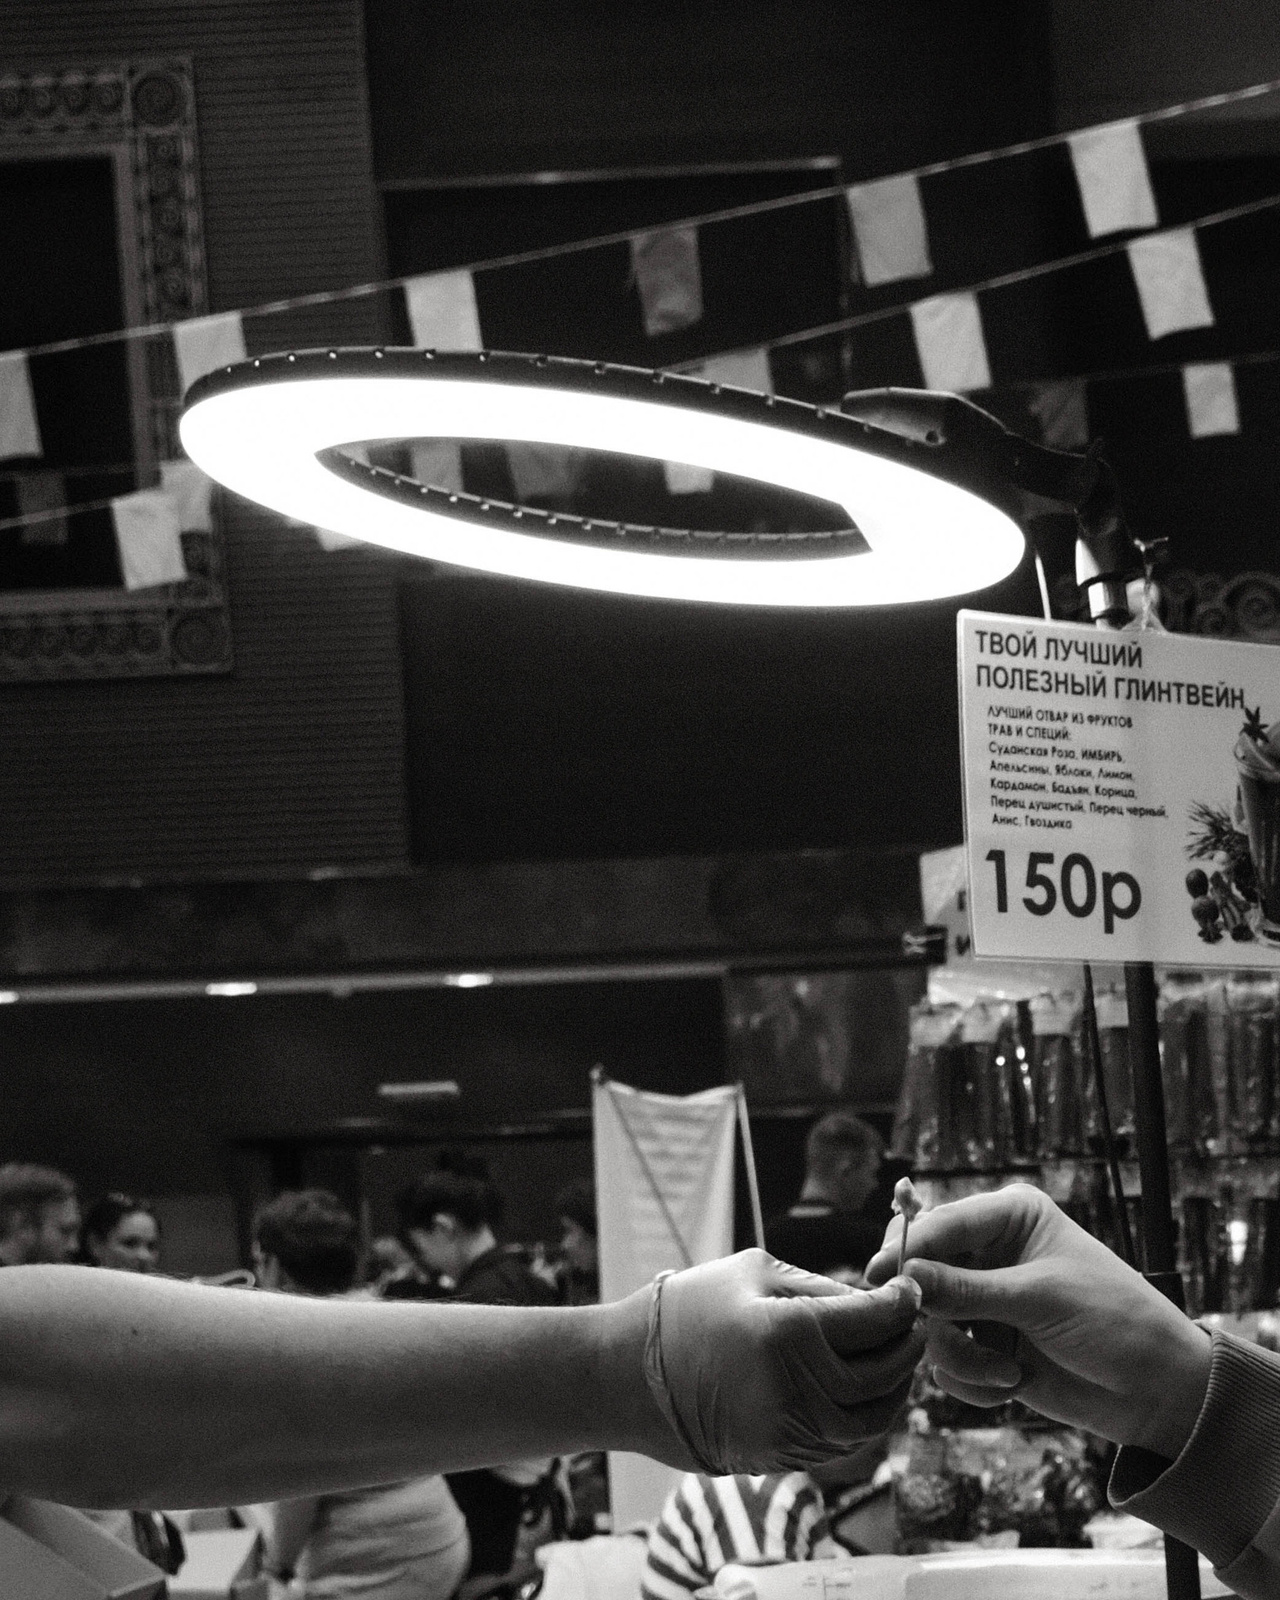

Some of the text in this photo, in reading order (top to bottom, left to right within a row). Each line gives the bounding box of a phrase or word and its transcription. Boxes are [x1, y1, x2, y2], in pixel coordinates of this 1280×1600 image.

[975, 630, 1142, 669] ТВОЙ ЛУЧШИЙ
[976, 664, 1244, 709] ПОЛЕЗНЫЙ ГЛИНТВЕЙН
[987, 705, 1133, 728] ЛУЧШИЙ ОТВАР ИЗ ФРУКТОВ
[987, 722, 1012, 736] ТРАВ
[1016, 726, 1023, 737] И
[988, 741, 1048, 757] Суданская
[991, 794, 1026, 811] Перец
[1089, 801, 1124, 816] Перец
[1025, 814, 1073, 829] Гвоздика
[985, 848, 1142, 935] 150р
